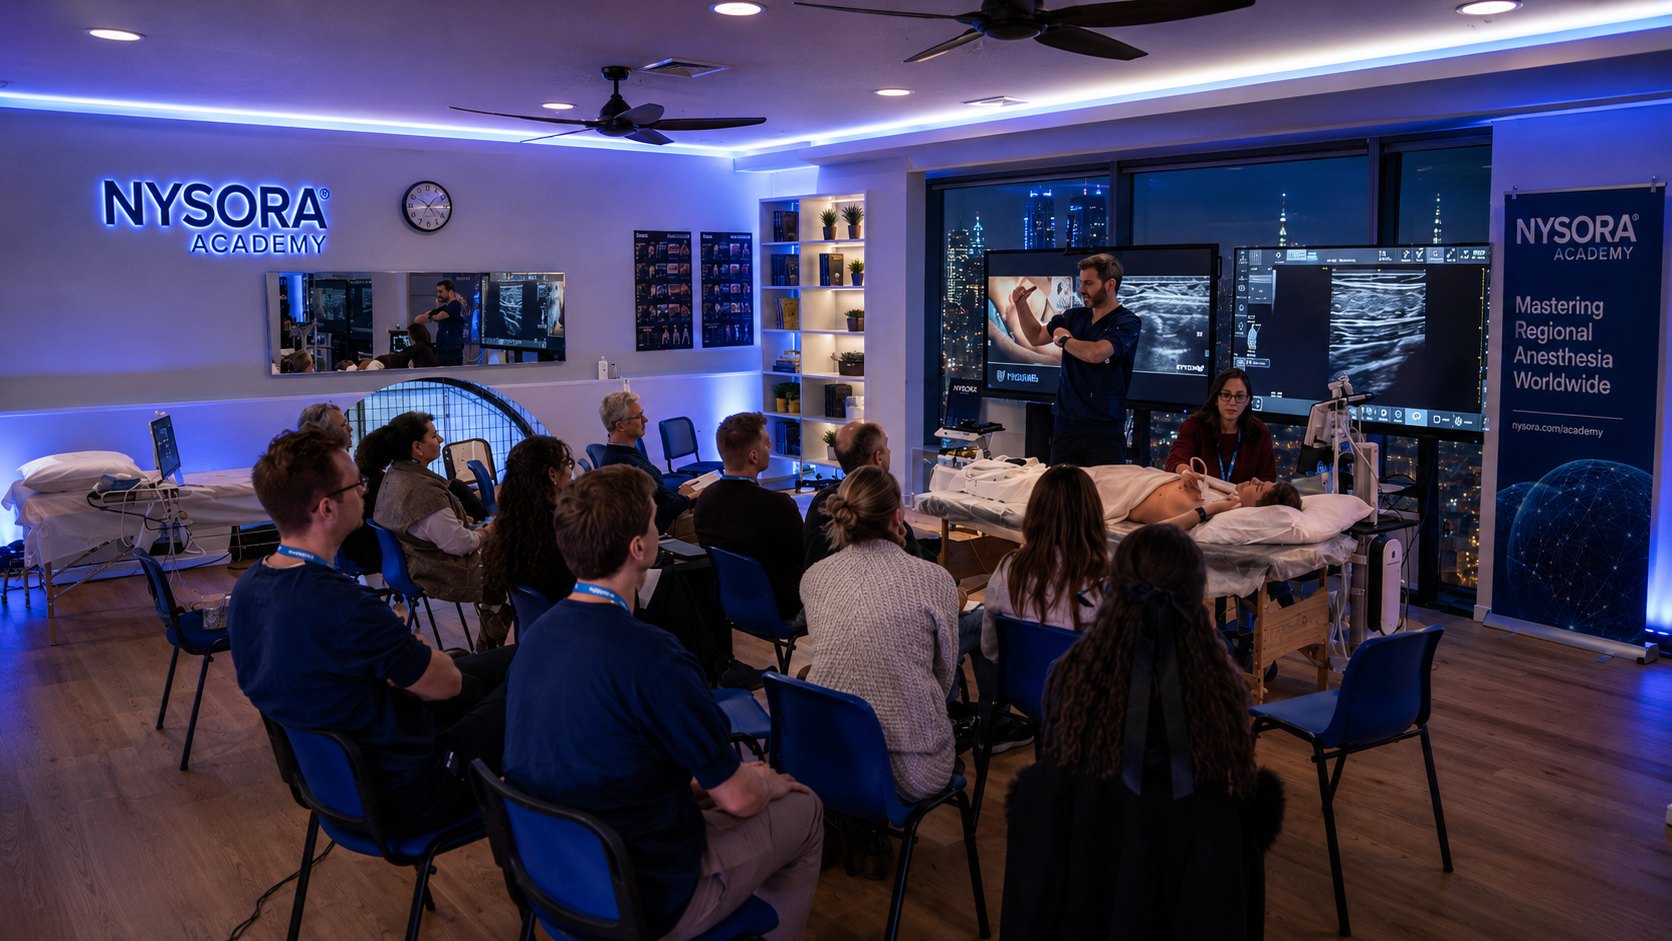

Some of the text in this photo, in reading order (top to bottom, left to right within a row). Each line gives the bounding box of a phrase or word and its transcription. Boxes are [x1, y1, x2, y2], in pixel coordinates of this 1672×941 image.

[191, 234, 326, 254] ACADEMY
[1553, 247, 1633, 261] ACADEMY
[1515, 296, 1604, 319] Mastering
[1515, 321, 1593, 343] Regional
[1513, 346, 1613, 368] Anesthesia
[1513, 371, 1611, 394] Worldwide
[1512, 421, 1604, 438] nysora.com/academy
